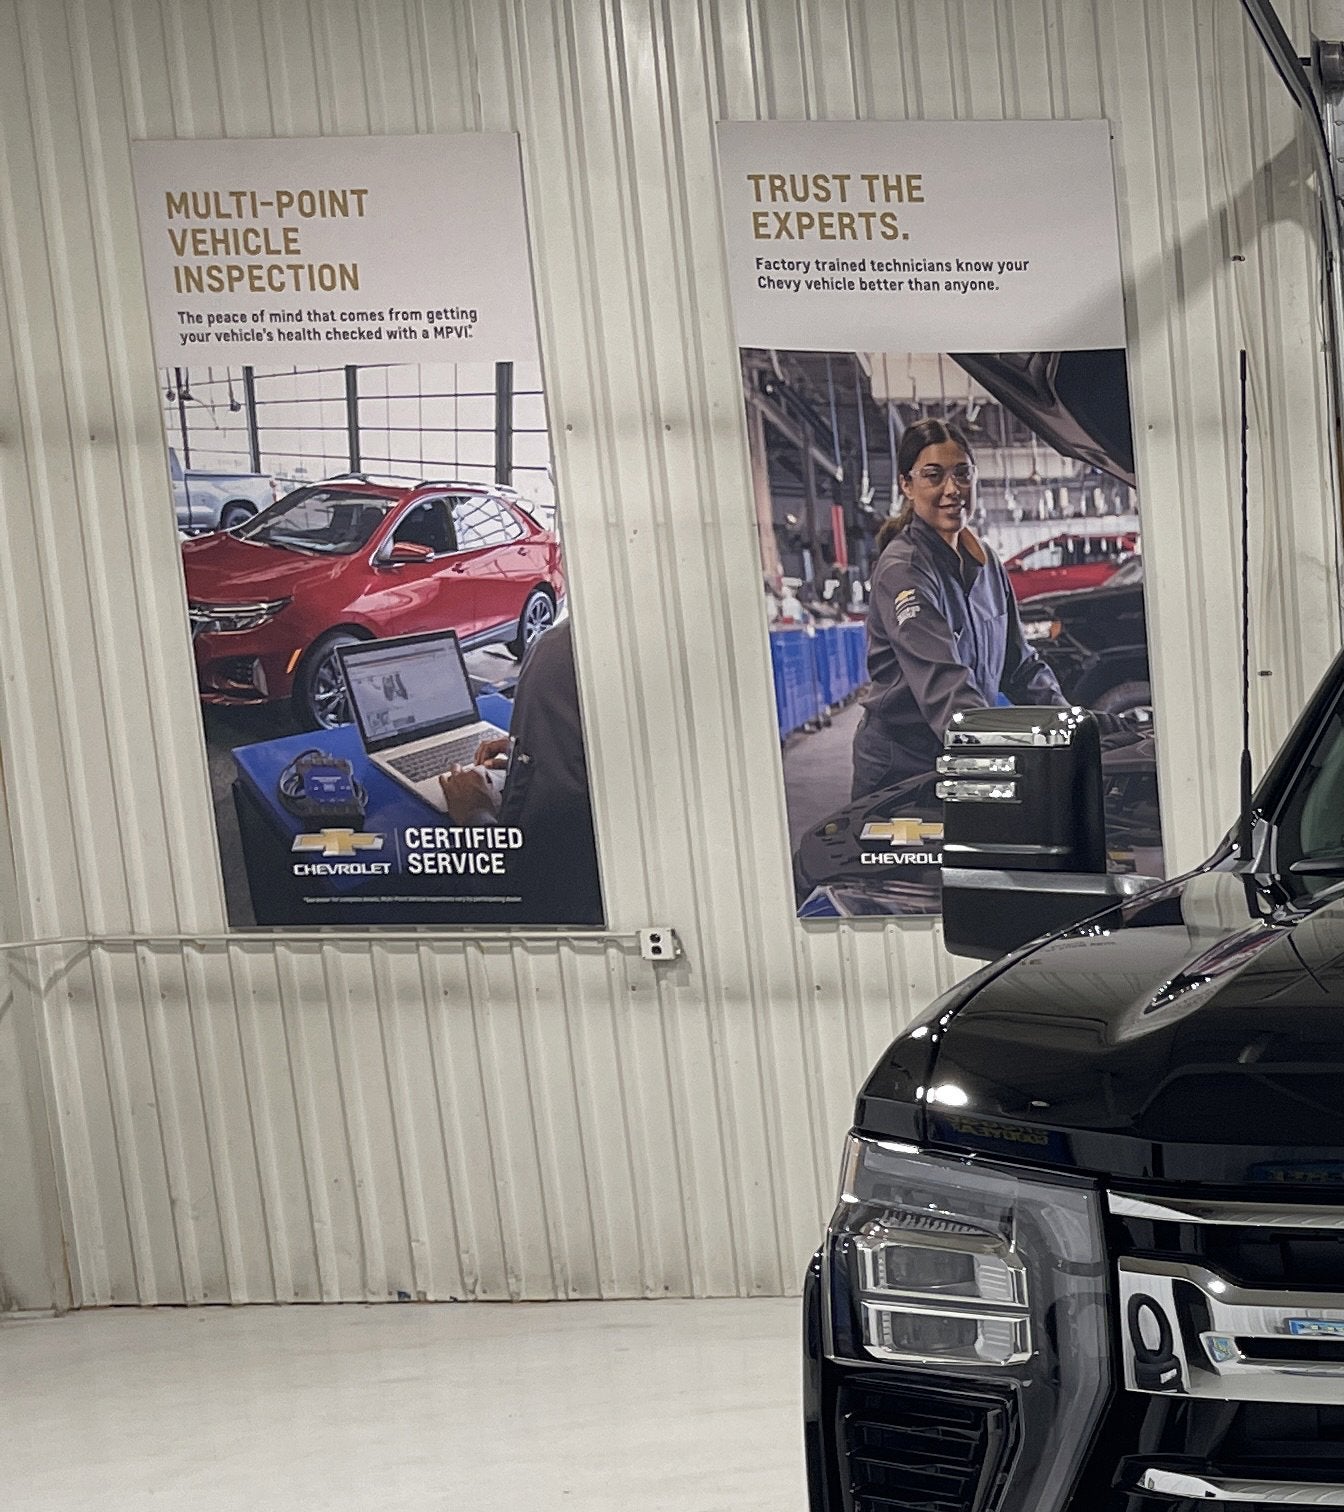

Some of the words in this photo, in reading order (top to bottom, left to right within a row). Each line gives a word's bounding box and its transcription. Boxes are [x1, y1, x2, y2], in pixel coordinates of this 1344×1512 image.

[747, 174, 850, 203] TRUST
[861, 174, 924, 203] THE
[165, 188, 368, 220] MULTI-POINT
[752, 211, 909, 241] EXPERTS.
[168, 227, 301, 257] VEHICLE
[755, 257, 811, 273] Factory
[815, 258, 866, 272] trained
[870, 258, 952, 272] technicians
[956, 258, 994, 272] know
[998, 259, 1030, 274] your
[173, 263, 360, 293] INSPECTION
[757, 276, 802, 292] Chevy
[805, 276, 855, 291] vehicle
[859, 277, 904, 292] better
[908, 278, 940, 291] than
[944, 279, 1000, 294] anyone.
[178, 311, 203, 325] The
[207, 312, 247, 327] peace
[252, 309, 266, 323] of
[270, 309, 302, 323] mind
[307, 309, 336, 323] that
[340, 310, 385, 322] comes
[389, 307, 422, 322] from
[427, 307, 478, 324] getting
[180, 331, 211, 346] your
[215, 328, 274, 342] vehicle's
[278, 327, 321, 341] health
[325, 326, 382, 341] checked
[386, 325, 417, 339] with
[422, 328, 429, 339] a
[405, 827, 523, 850] CERTIFIED
[293, 862, 392, 876] CHEVROLET
[408, 852, 506, 875] SERVICE
